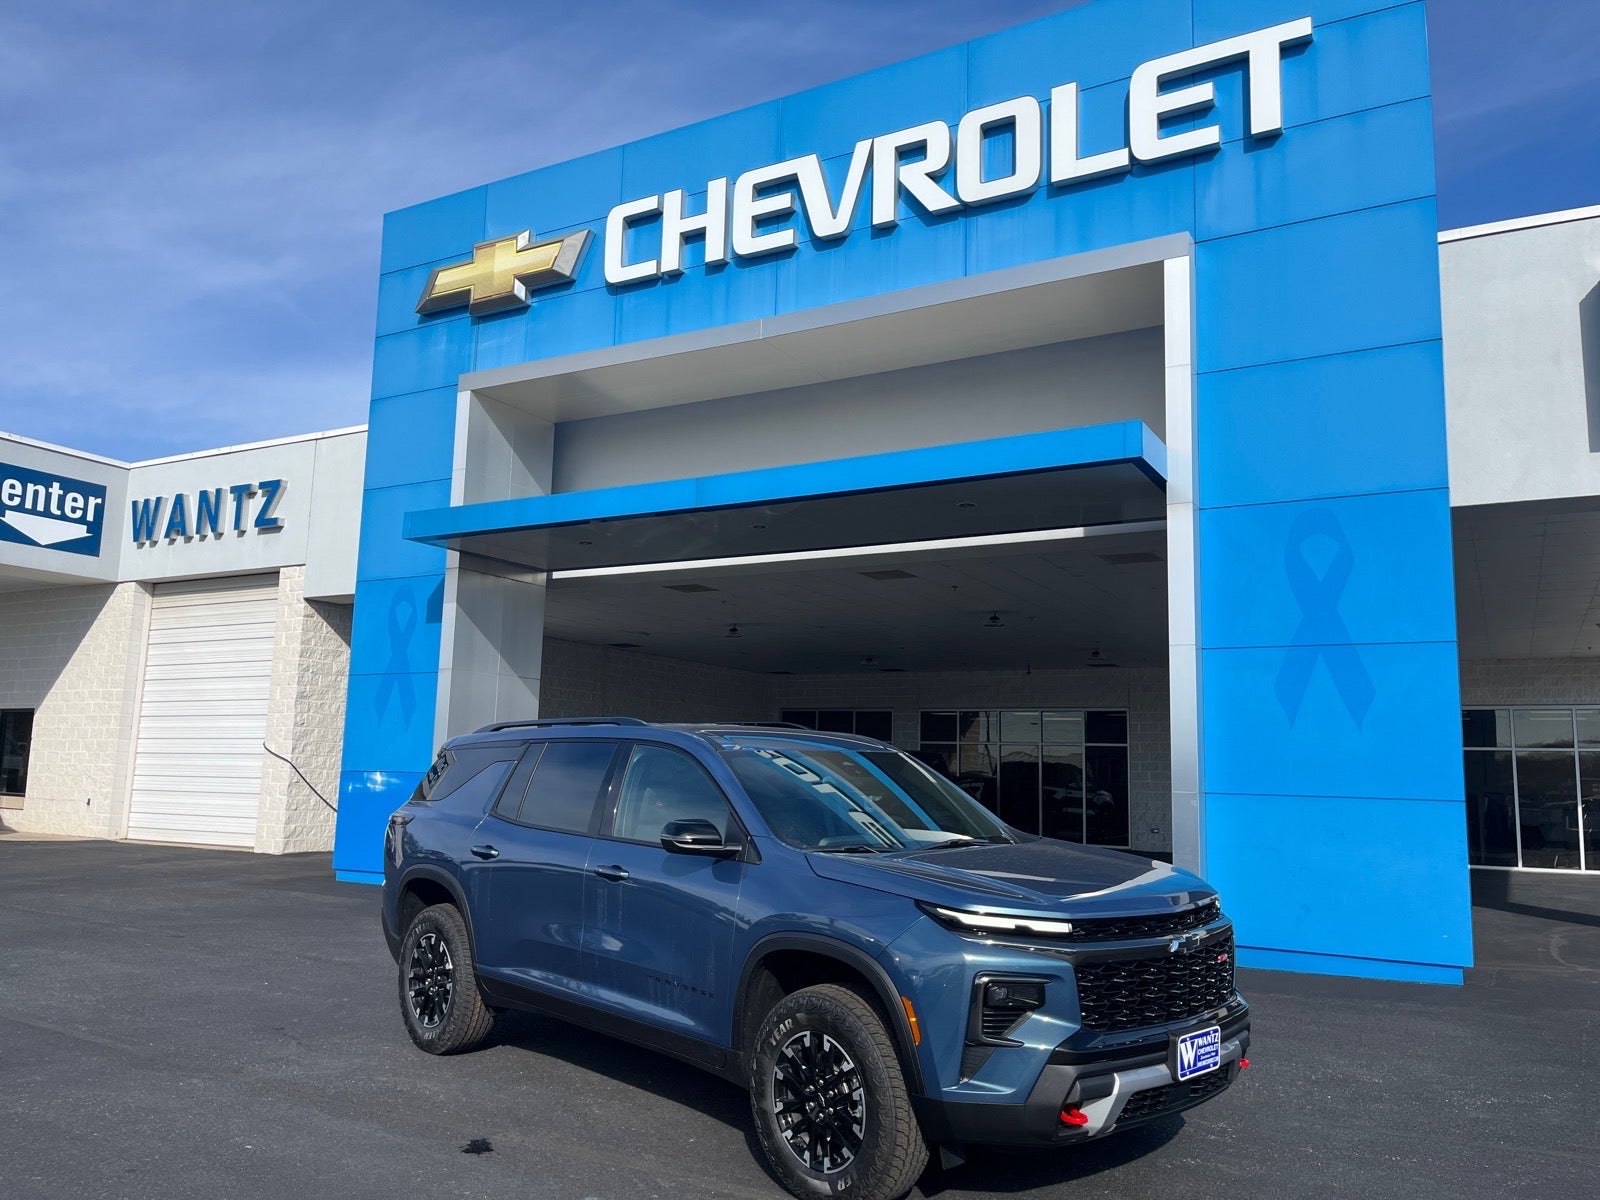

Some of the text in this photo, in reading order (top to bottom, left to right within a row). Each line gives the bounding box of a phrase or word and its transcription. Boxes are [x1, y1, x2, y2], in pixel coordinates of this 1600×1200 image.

[604, 16, 1313, 287] CHEVROLET
[131, 479, 286, 545] WANTZ
[1180, 1039, 1198, 1070] W
[1198, 1033, 1219, 1047] WANTZ
